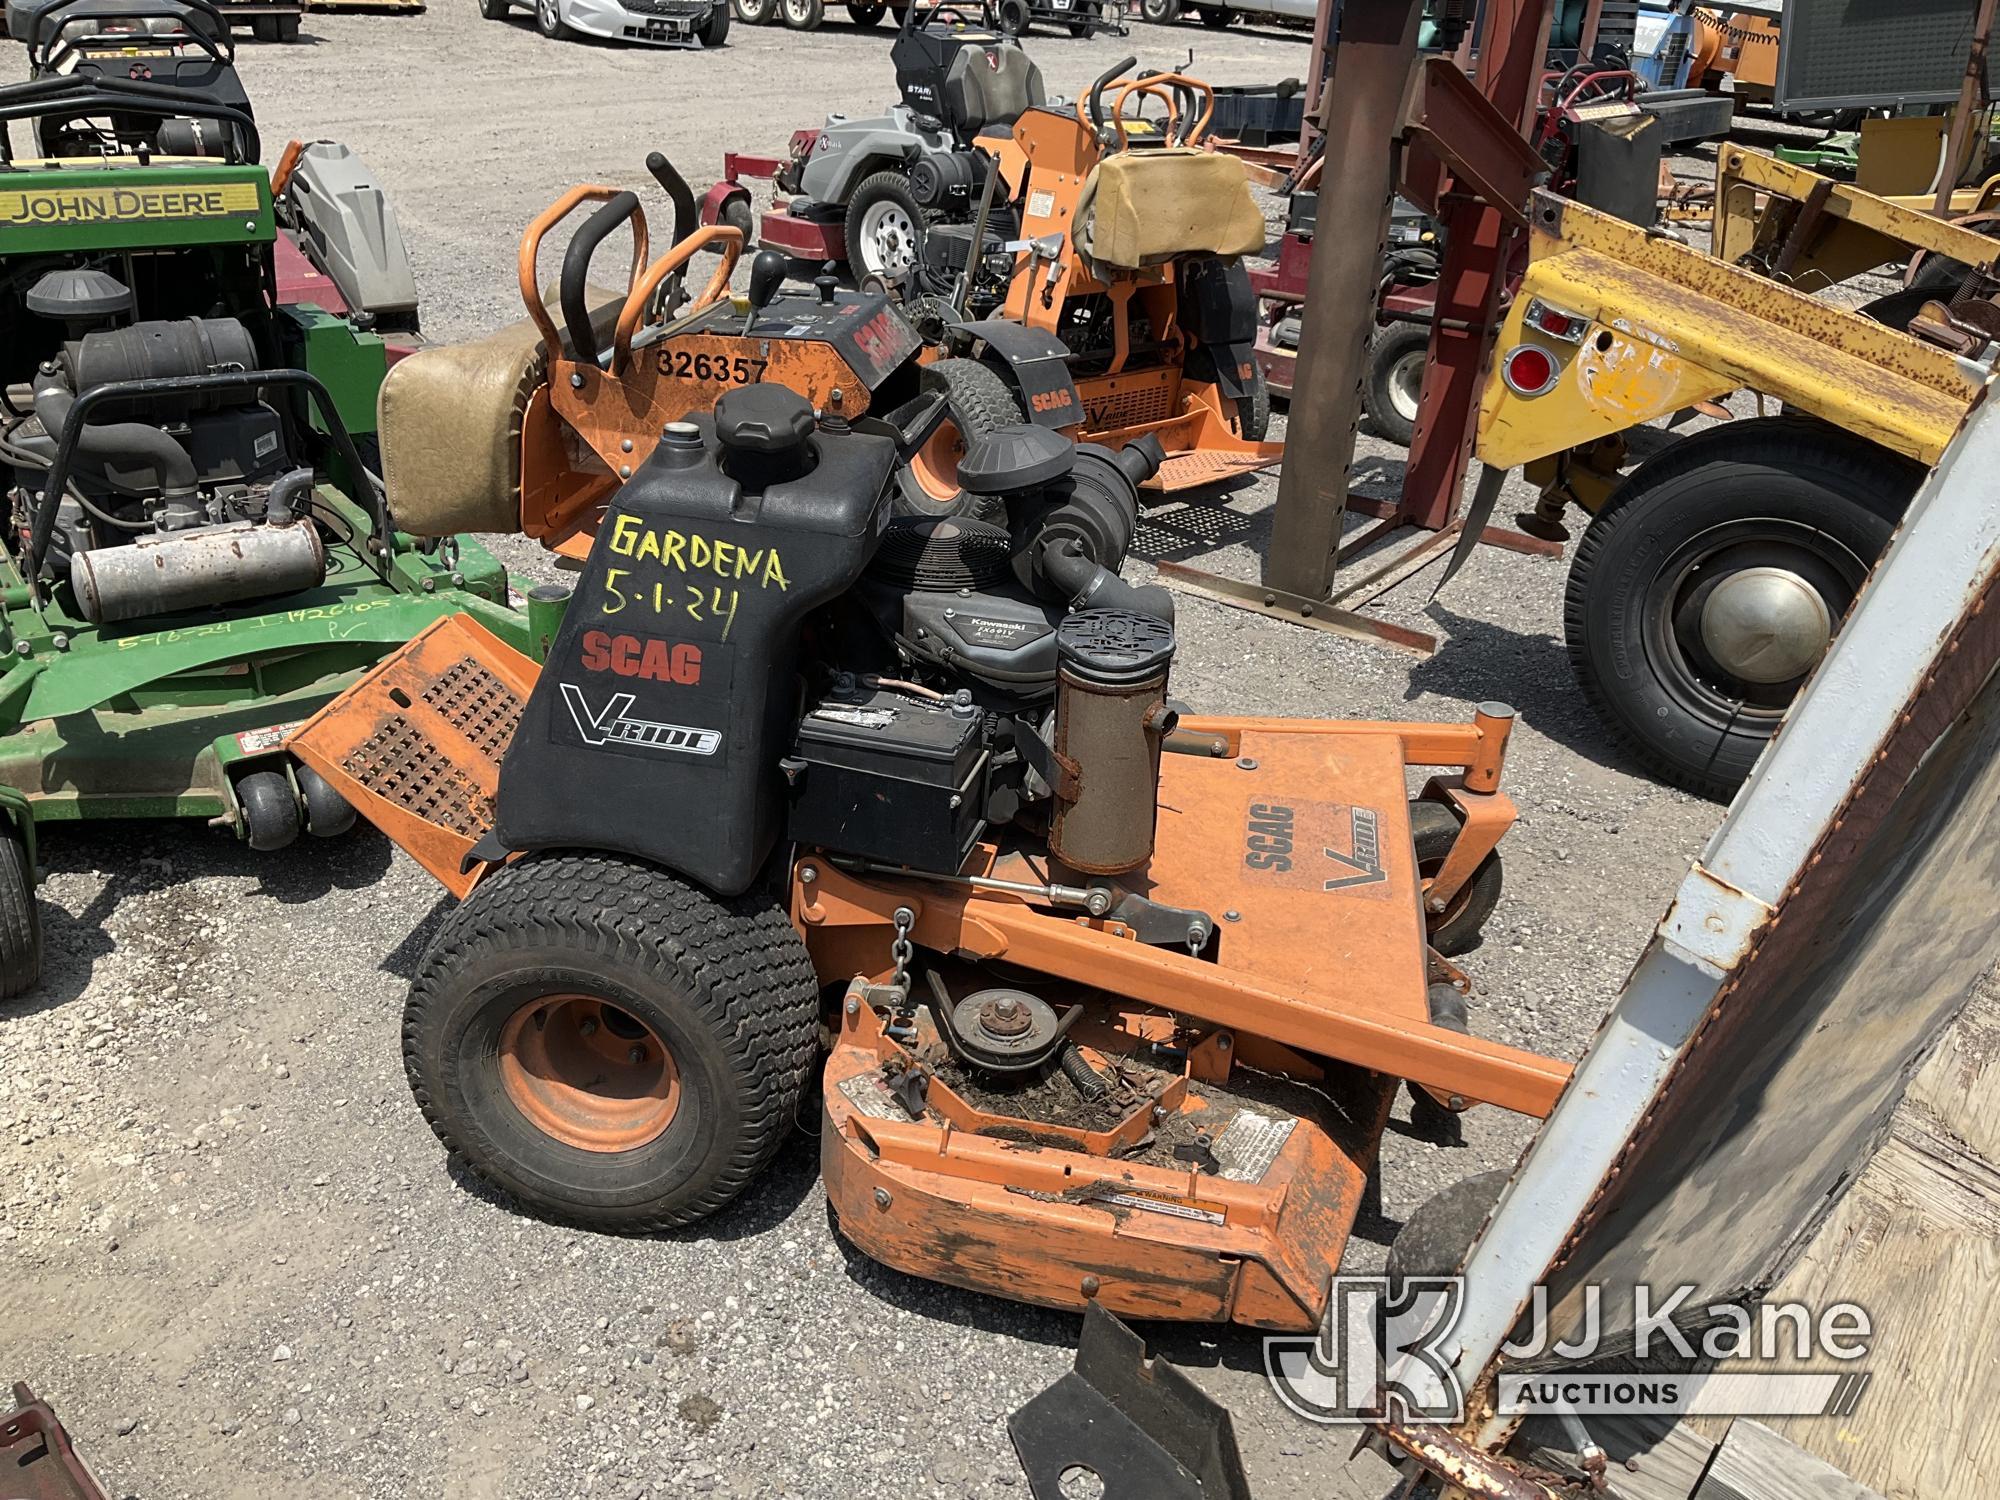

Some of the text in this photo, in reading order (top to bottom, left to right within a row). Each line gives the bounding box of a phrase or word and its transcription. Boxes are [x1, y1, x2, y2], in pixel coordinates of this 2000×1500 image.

[11, 190, 226, 222] JOHN DEERE
[655, 350, 768, 384] 326357
[1031, 388, 1073, 412] SCAG
[1090, 404, 1129, 426] V-RIDE
[608, 514, 792, 592] GARDENA
[971, 617, 1026, 631] Kawasaki
[581, 630, 703, 686] SCAG
[560, 682, 722, 756] V-RIDE
[1245, 803, 1294, 873] SCAG
[1323, 806, 1389, 891] V-RIDE
[1145, 1190, 1183, 1204] WARNING
